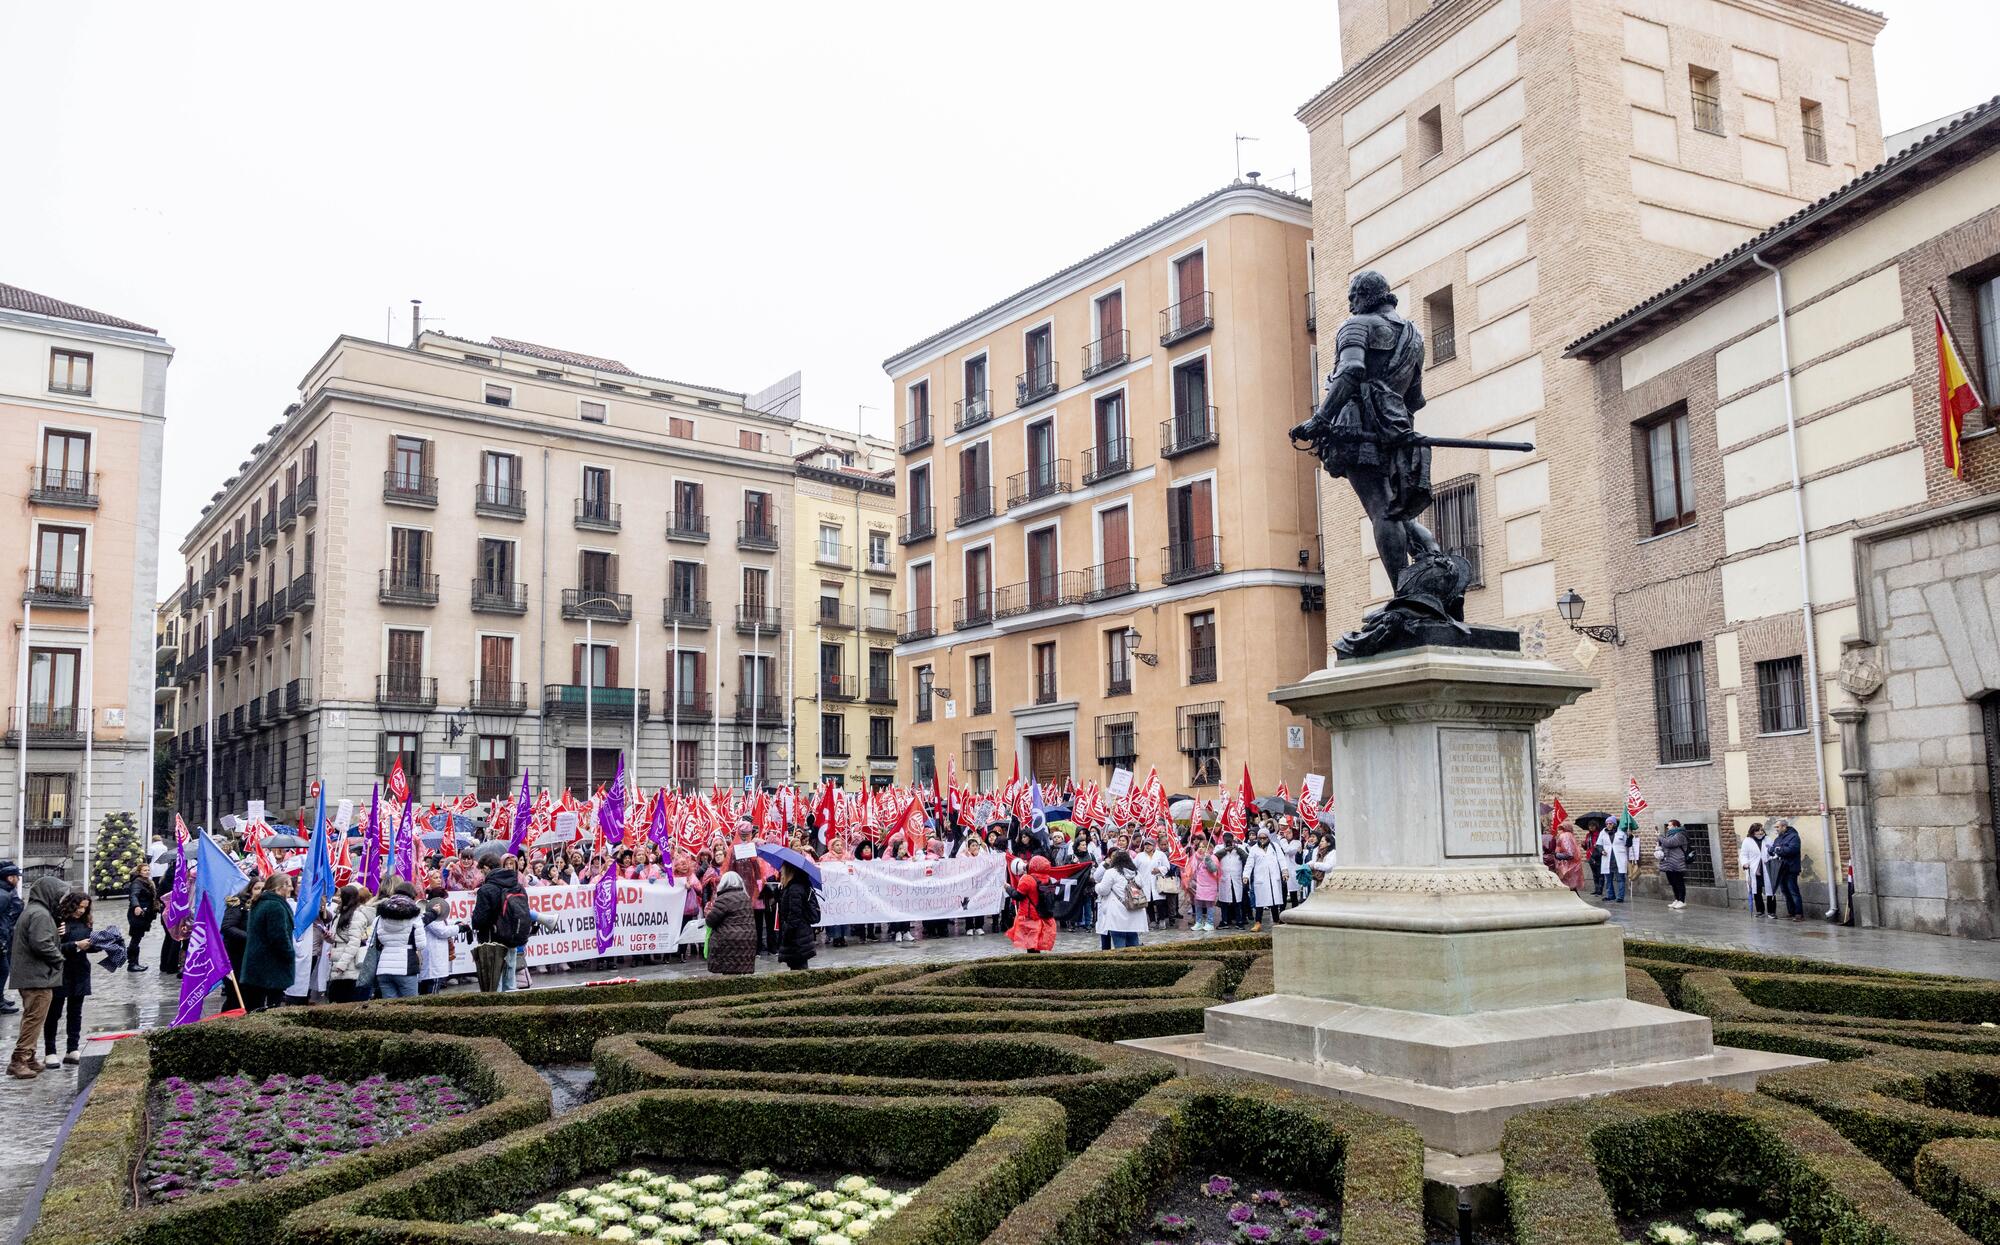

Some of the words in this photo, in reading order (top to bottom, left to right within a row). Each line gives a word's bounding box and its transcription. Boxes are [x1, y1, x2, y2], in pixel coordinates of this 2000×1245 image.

[568, 918, 574, 932] Y
[621, 911, 669, 927] VALORADA
[630, 933, 648, 942] UGT
[537, 943, 549, 956] DE
[552, 941, 569, 955] LOS
[630, 943, 648, 951] UGT
